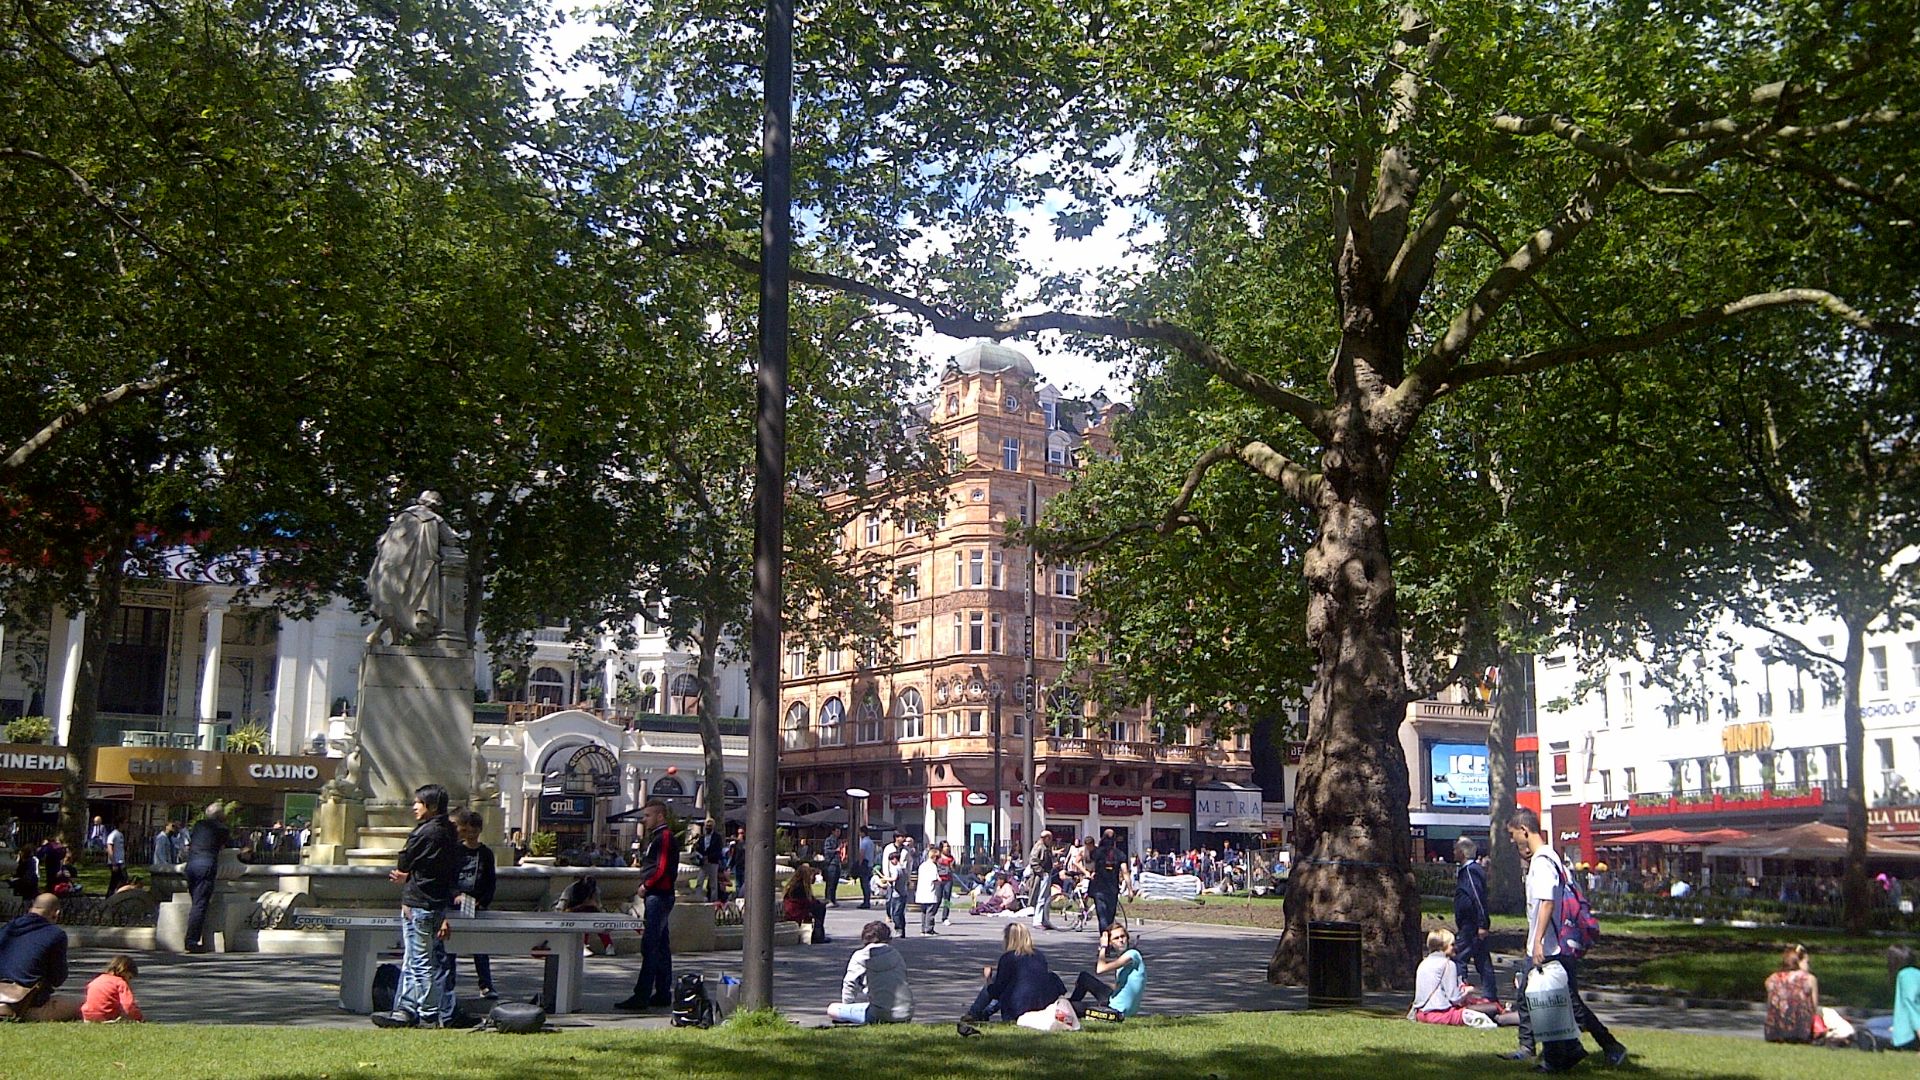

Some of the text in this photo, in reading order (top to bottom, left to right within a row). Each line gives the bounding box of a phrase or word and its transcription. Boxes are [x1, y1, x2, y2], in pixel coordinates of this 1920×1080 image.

[1860, 700, 1916, 718] SCHOOL OF
[0, 753, 66, 770] INEMA
[1449, 754, 1486, 775] ICE
[249, 763, 319, 780] CASINO
[1198, 799, 1261, 815] METRA
[1590, 802, 1630, 821] Pizza Hut
[1867, 811, 1890, 825] LLA
